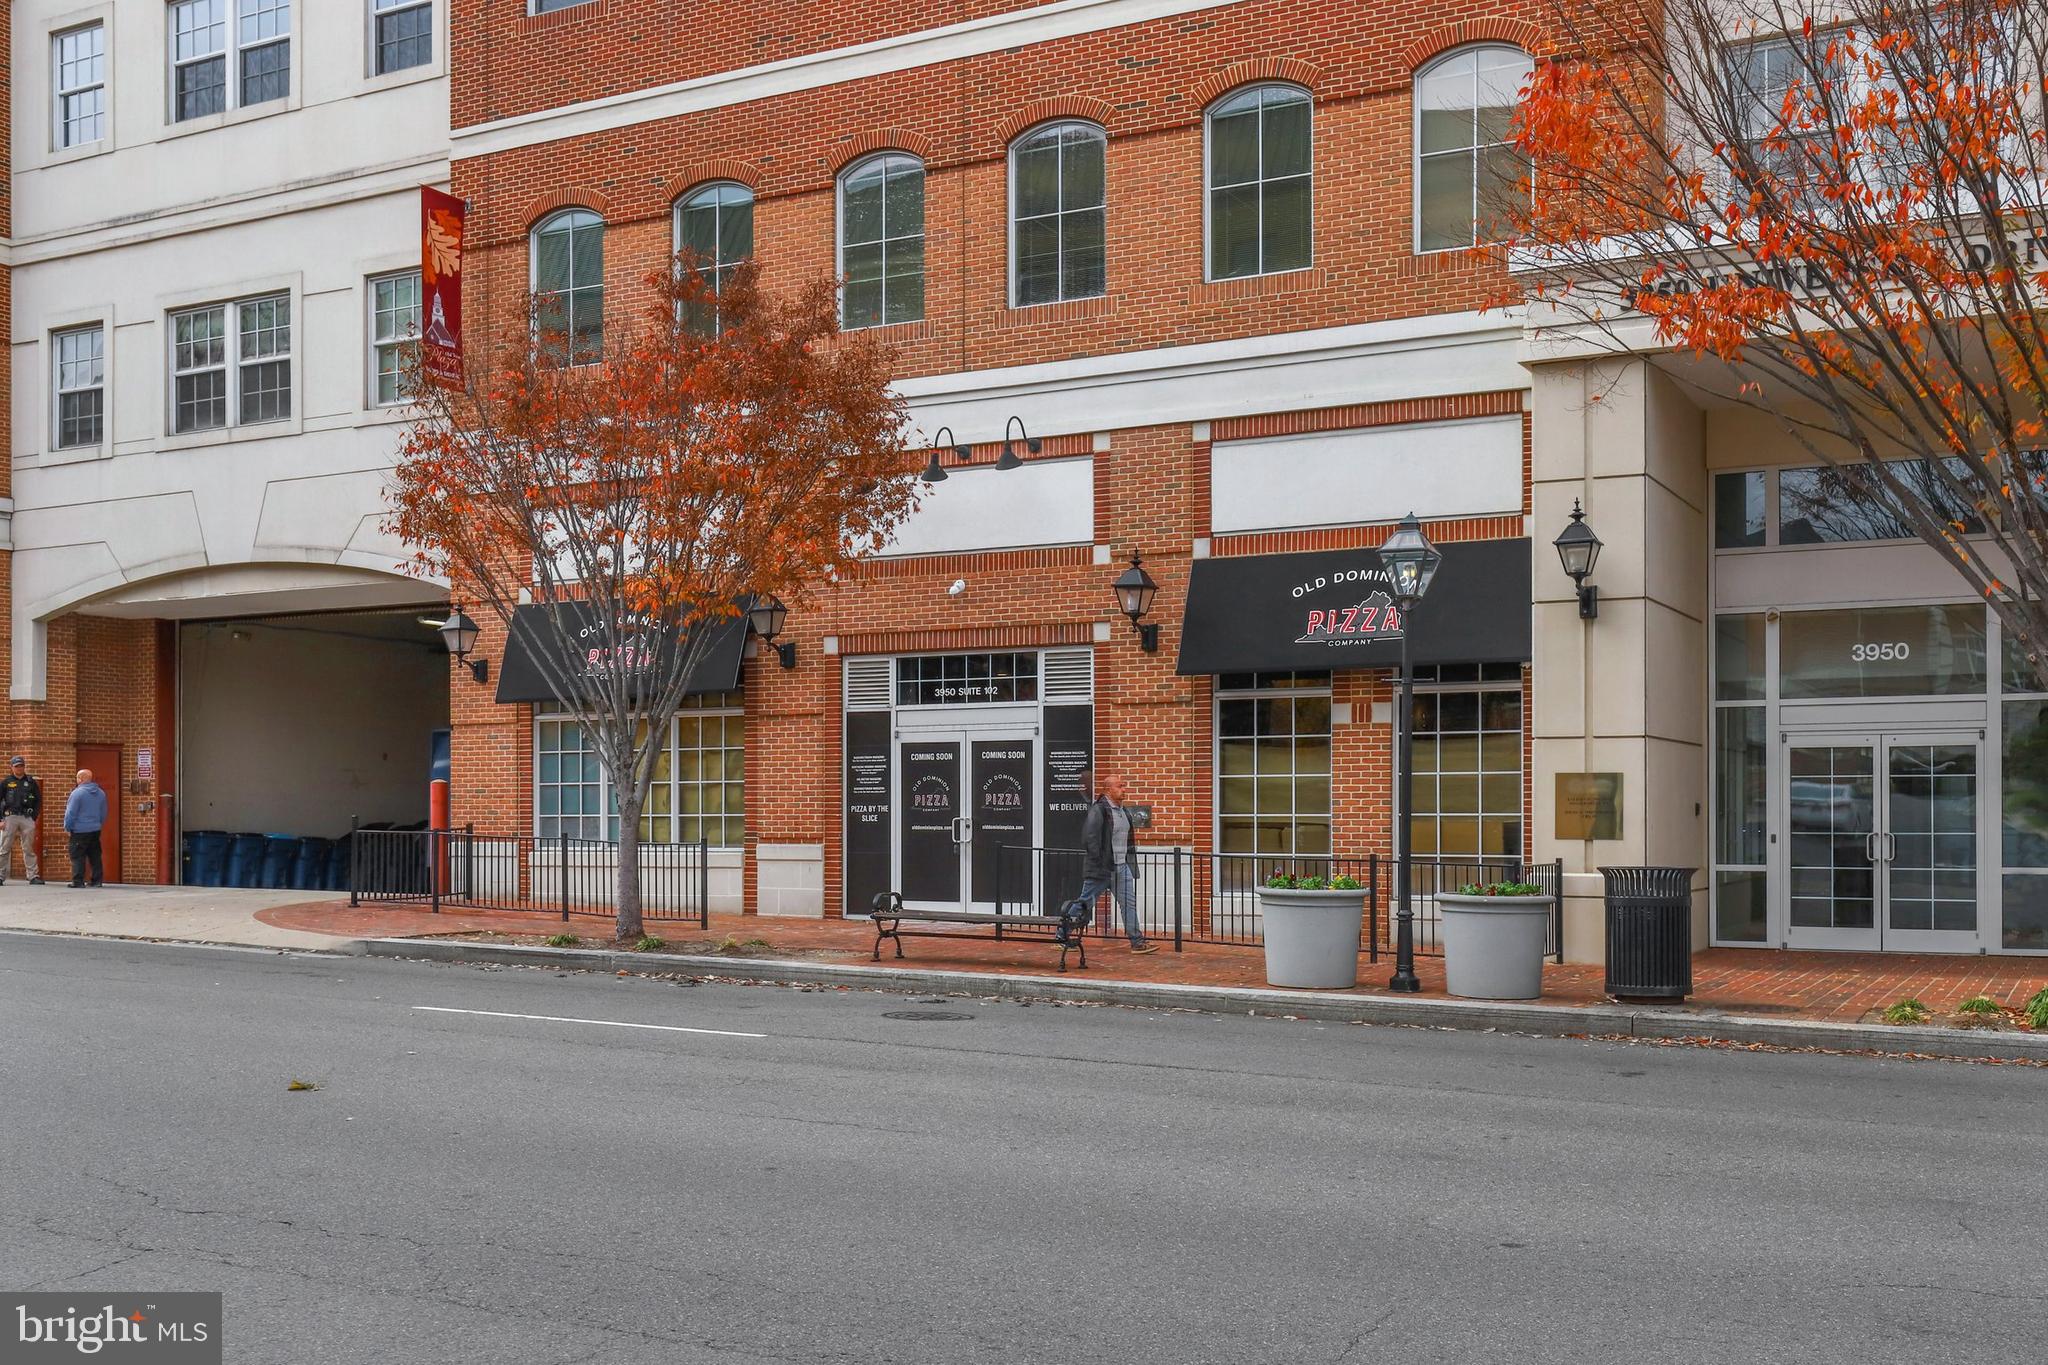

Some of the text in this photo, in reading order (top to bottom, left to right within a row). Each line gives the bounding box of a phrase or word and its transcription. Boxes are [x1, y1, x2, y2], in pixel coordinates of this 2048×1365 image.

[1292, 577, 1326, 598] OLD
[1306, 606, 1400, 635] PIZZA
[1327, 639, 1372, 647] COMPANY
[1851, 642, 1910, 661] 3950
[934, 686, 998, 697] 3950 SUITE 102
[936, 752, 953, 760] SOON
[981, 751, 1025, 759] COMING SOON
[912, 775, 950, 792] OLD DOMINION
[983, 773, 1022, 791] OLD DOMINION
[914, 794, 948, 806] PIZZA
[985, 793, 1021, 805] PIZZA
[877, 804, 889, 812] THE
[1049, 803, 1087, 811] WE DELIVER
[861, 814, 878, 822] SLICE
